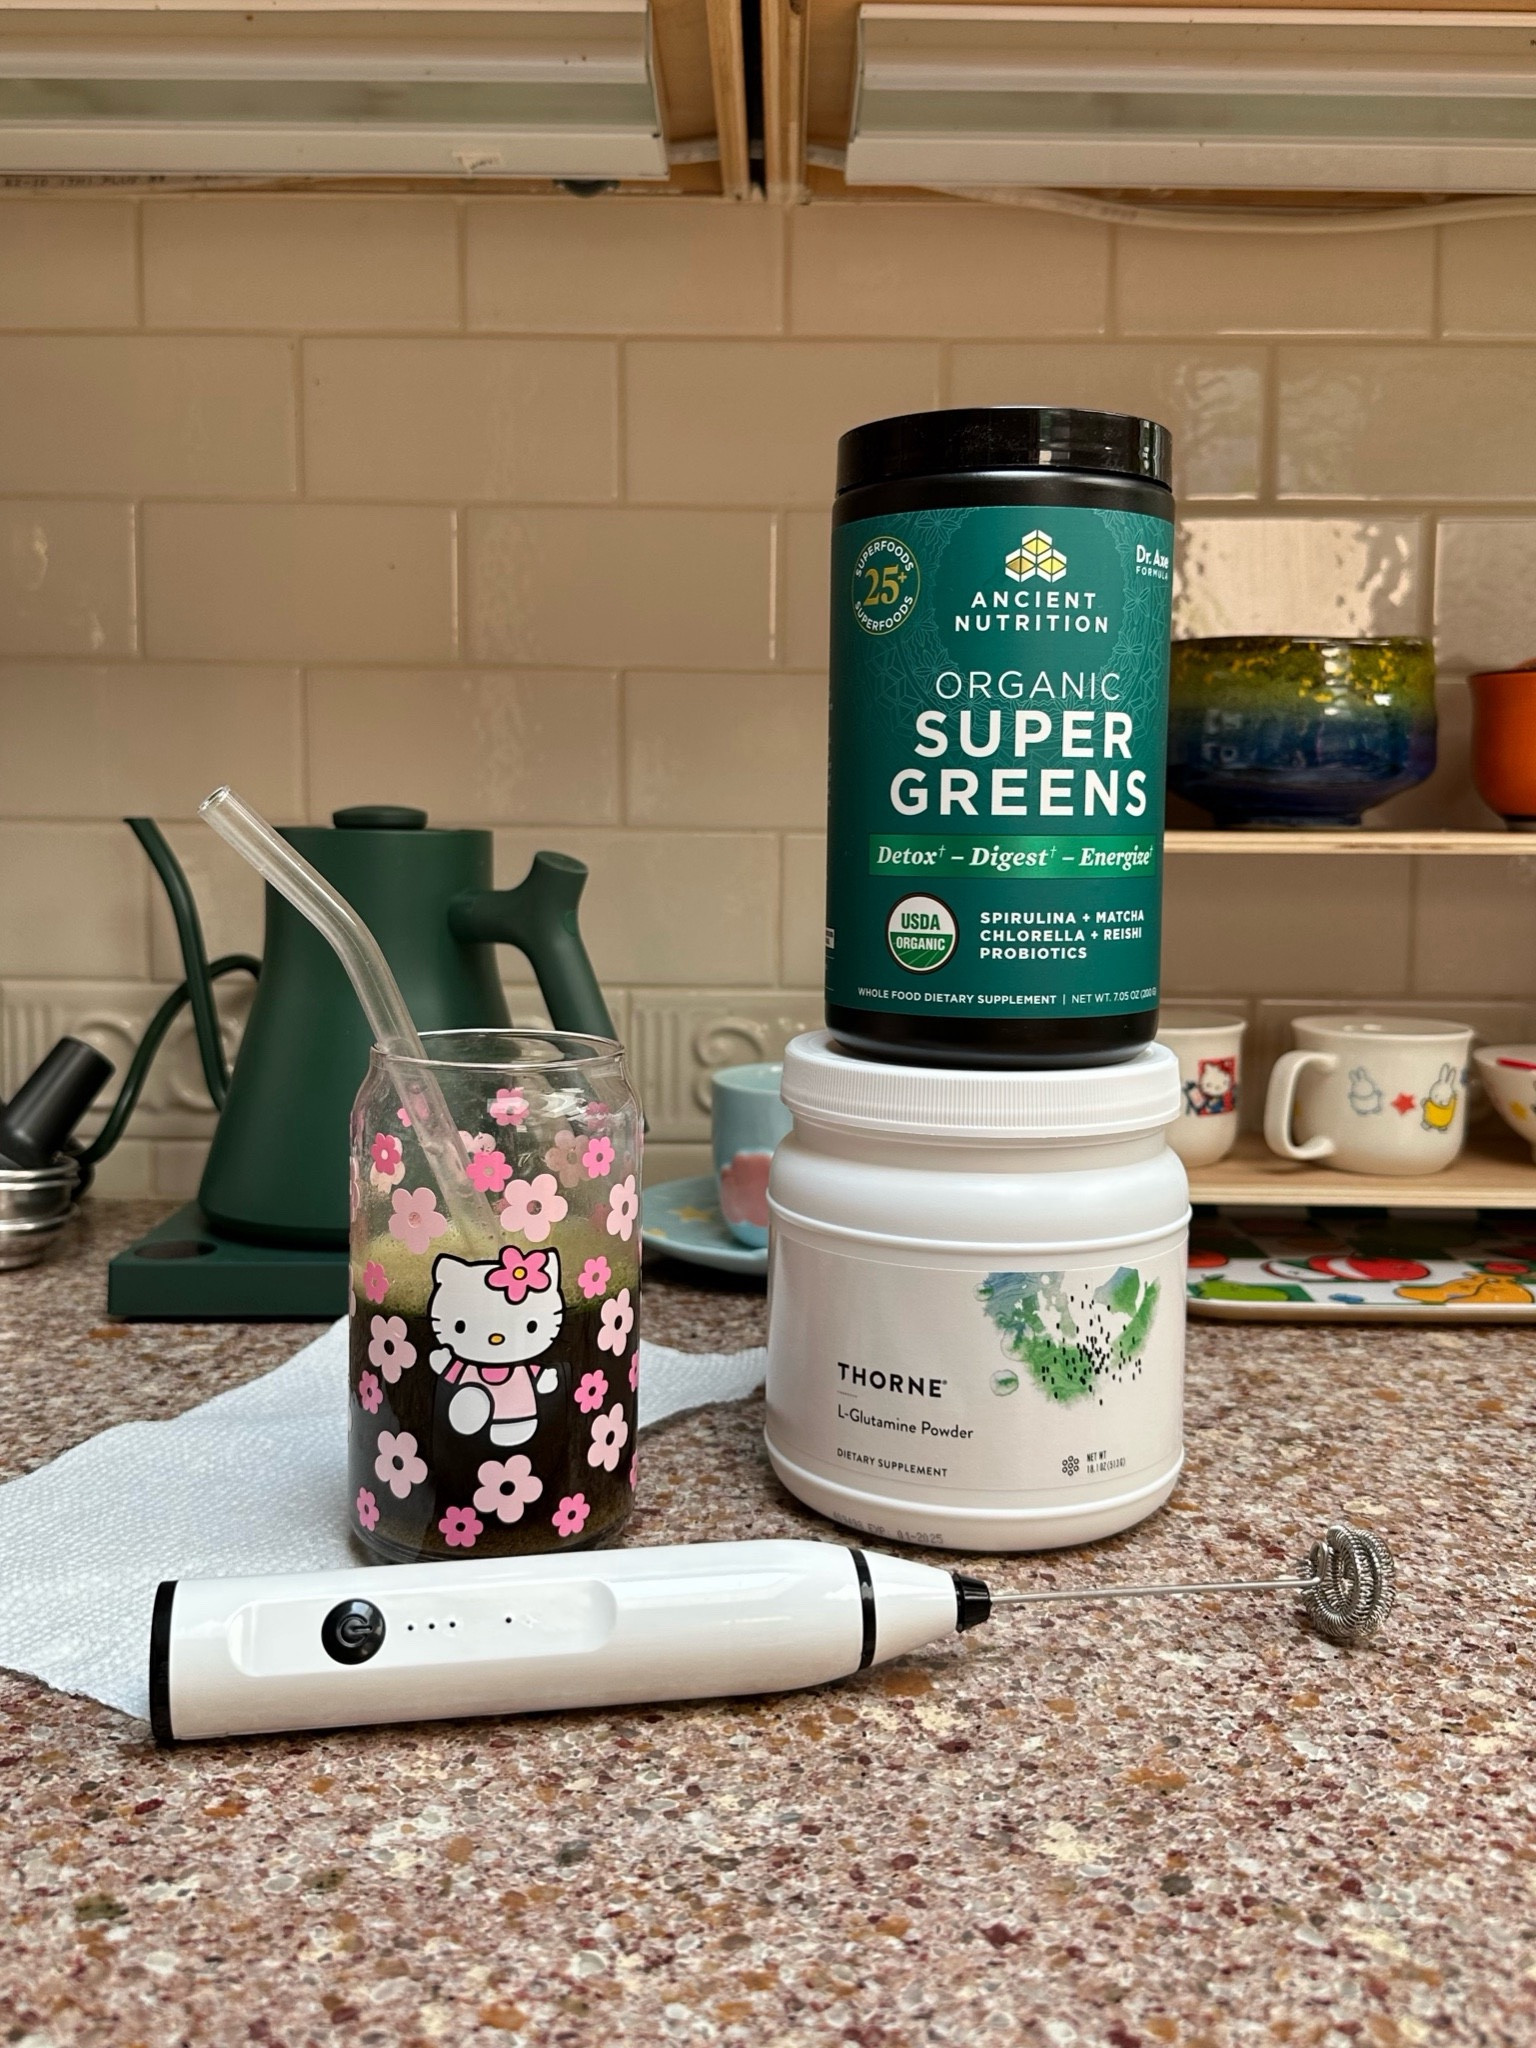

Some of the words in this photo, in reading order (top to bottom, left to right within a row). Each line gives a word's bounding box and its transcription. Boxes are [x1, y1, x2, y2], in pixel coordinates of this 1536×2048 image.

[855, 540, 914, 577] SUPERFOODS
[1136, 544, 1152, 565] Dr.
[1153, 549, 1169, 569] Axe
[1136, 565, 1168, 580] FORMULA
[971, 591, 1096, 609] ANCIENT
[855, 596, 913, 631] SUPERFOODS
[955, 615, 1108, 633] NUTRITION
[935, 671, 1120, 700] ORGANIC
[914, 710, 1133, 758] SUPER
[890, 768, 1147, 817] GREENS
[901, 913, 941, 931] USDA
[980, 912, 1076, 925] SPIRULINA
[1096, 910, 1145, 924] MATCHA
[896, 936, 946, 951] ORGANIC
[980, 929, 1085, 942] CHLORELLA
[1103, 927, 1142, 941] REISHI
[980, 947, 1087, 960] PROBIOTICS
[858, 987, 889, 999] WHOLE
[891, 990, 921, 1001] FOOD
[924, 993, 974, 1004] DIETARY
[977, 994, 1057, 1005] SUPPLEMENT
[1071, 994, 1092, 1004] NET
[1094, 992, 1112, 1003] WT.
[1113, 991, 1129, 1002] 7.05
[1130, 990, 1140, 1000] OZ
[838, 1404, 917, 1433] L-Glutamine
[921, 1421, 974, 1438] Powder
[837, 1448, 875, 1465] DIETARY
[878, 1459, 947, 1477] SUPPLEMENT
[1087, 1452, 1097, 1462] NET
